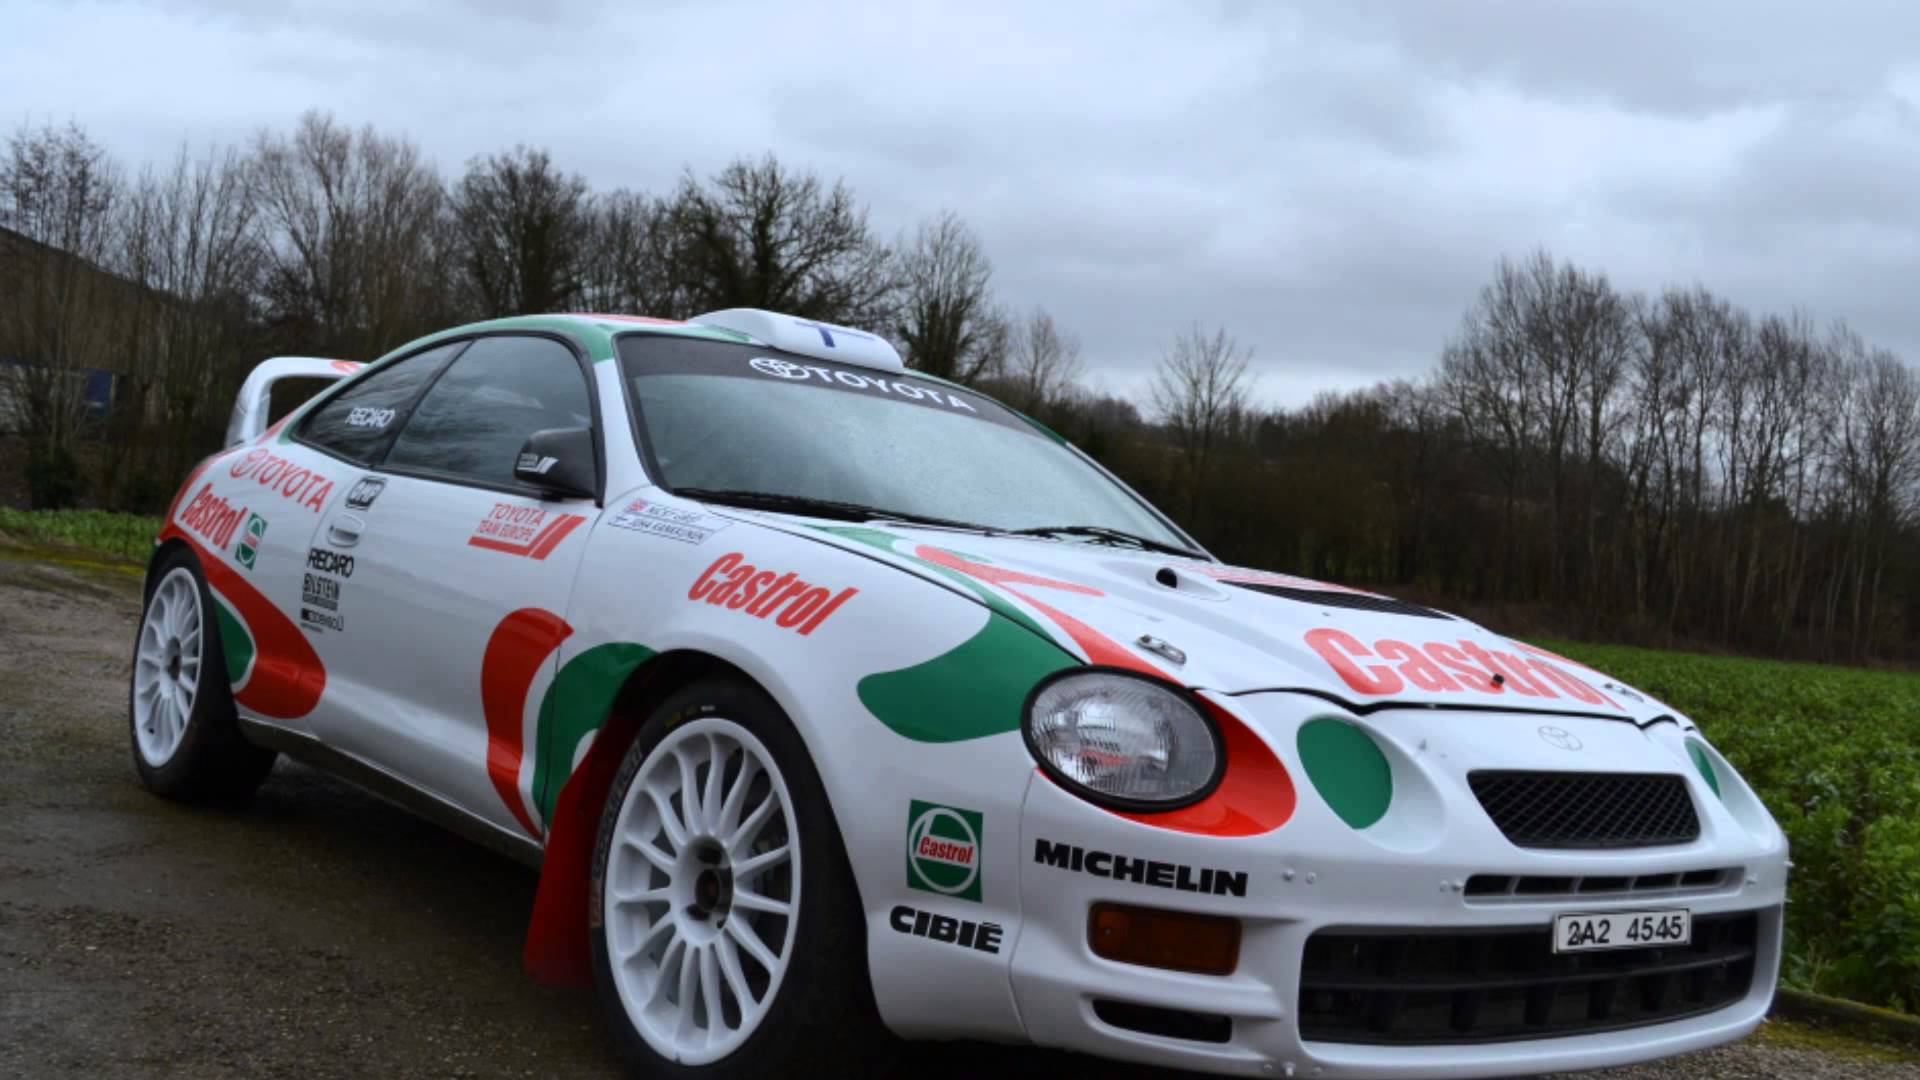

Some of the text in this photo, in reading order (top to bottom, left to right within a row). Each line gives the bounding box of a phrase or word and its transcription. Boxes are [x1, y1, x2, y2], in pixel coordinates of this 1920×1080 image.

[807, 365, 977, 413] TOYOTA
[345, 407, 395, 427] RECARO
[249, 455, 334, 513] TOYOTA
[180, 482, 248, 552] Castrol
[475, 519, 537, 542] TEAM EUROPE
[487, 501, 549, 527] TOYOTA
[306, 546, 355, 578] RECARO
[688, 551, 860, 636] Castrol
[1303, 627, 1626, 712] Castrol
[918, 835, 974, 865] Castrol
[1034, 838, 1248, 897] MICHELIN
[889, 904, 1003, 954] CIBIÉ
[1567, 915, 1683, 946] 2A2 4545
